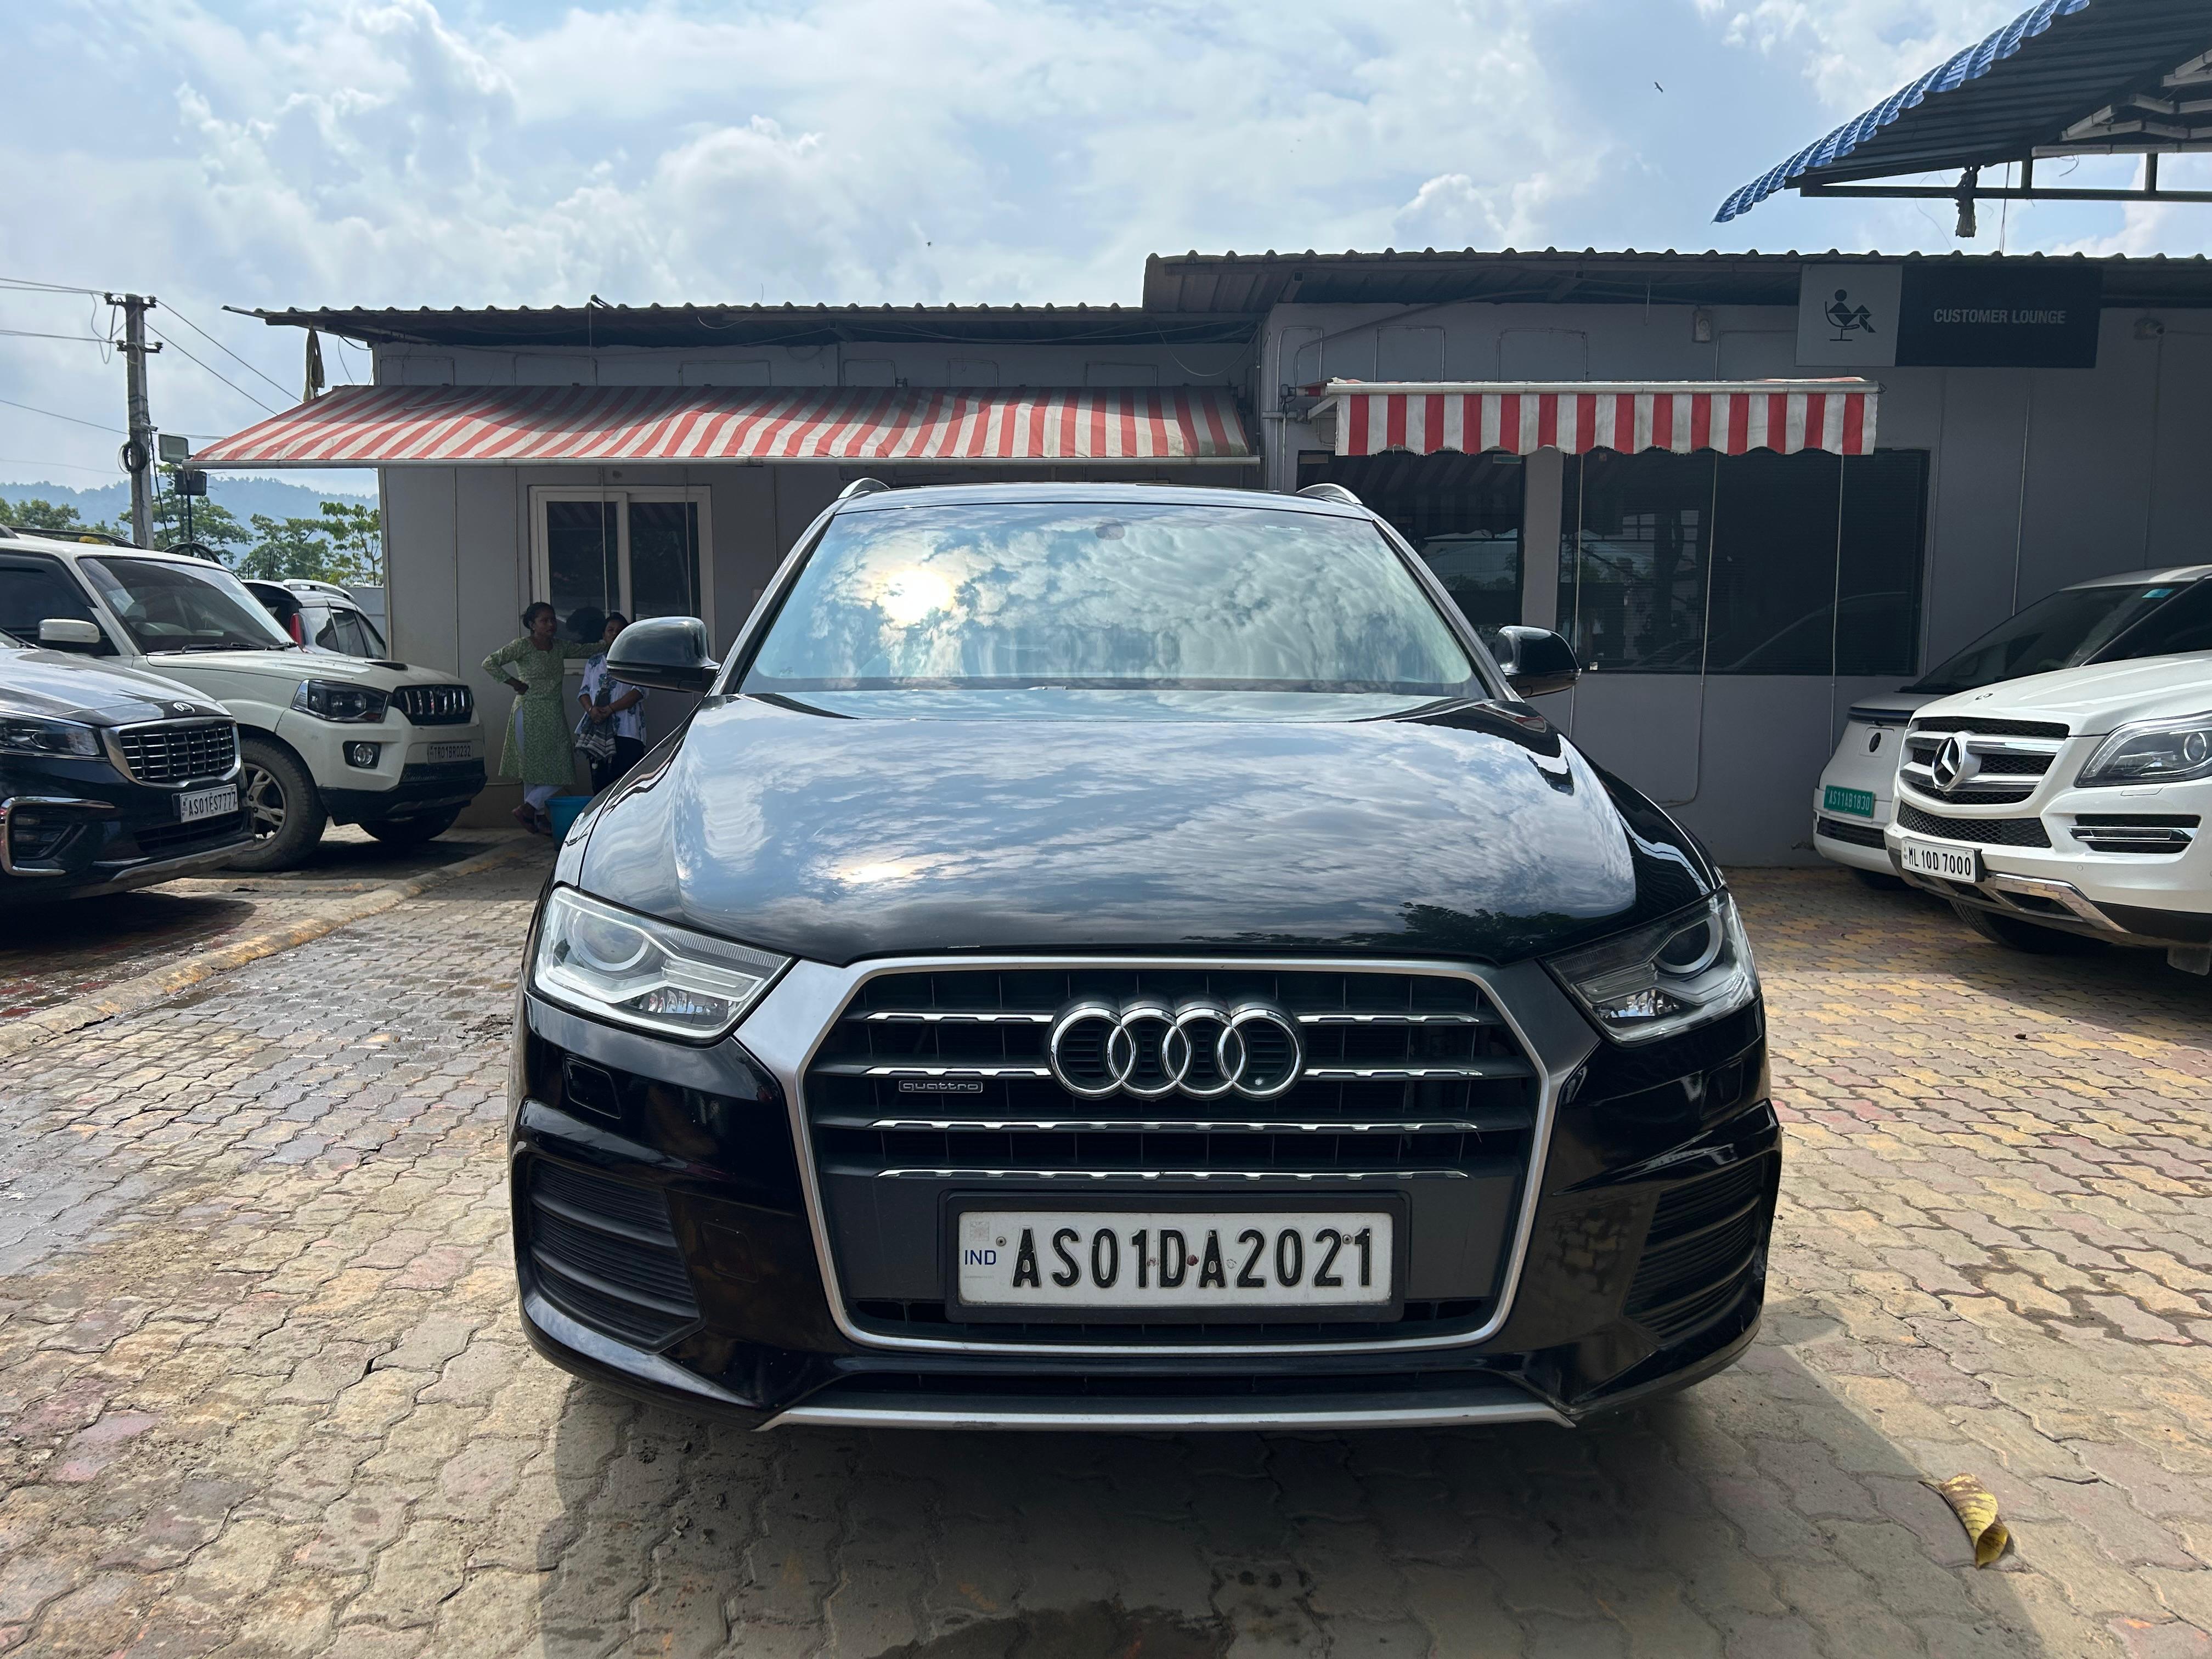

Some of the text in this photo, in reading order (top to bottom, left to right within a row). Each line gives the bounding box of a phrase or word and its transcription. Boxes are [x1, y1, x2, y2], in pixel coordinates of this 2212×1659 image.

[1934, 309, 2066, 324] CUSTOMER LOUNGE
[189, 791, 236, 817] AS01ES7777
[1829, 790, 1870, 811] AS11AB1830
[1909, 847, 1971, 876] ML 10D 7000
[903, 1082, 979, 1091] quattro
[964, 1250, 996, 1265] IND
[1012, 1227, 1373, 1288] AS01DA2021
